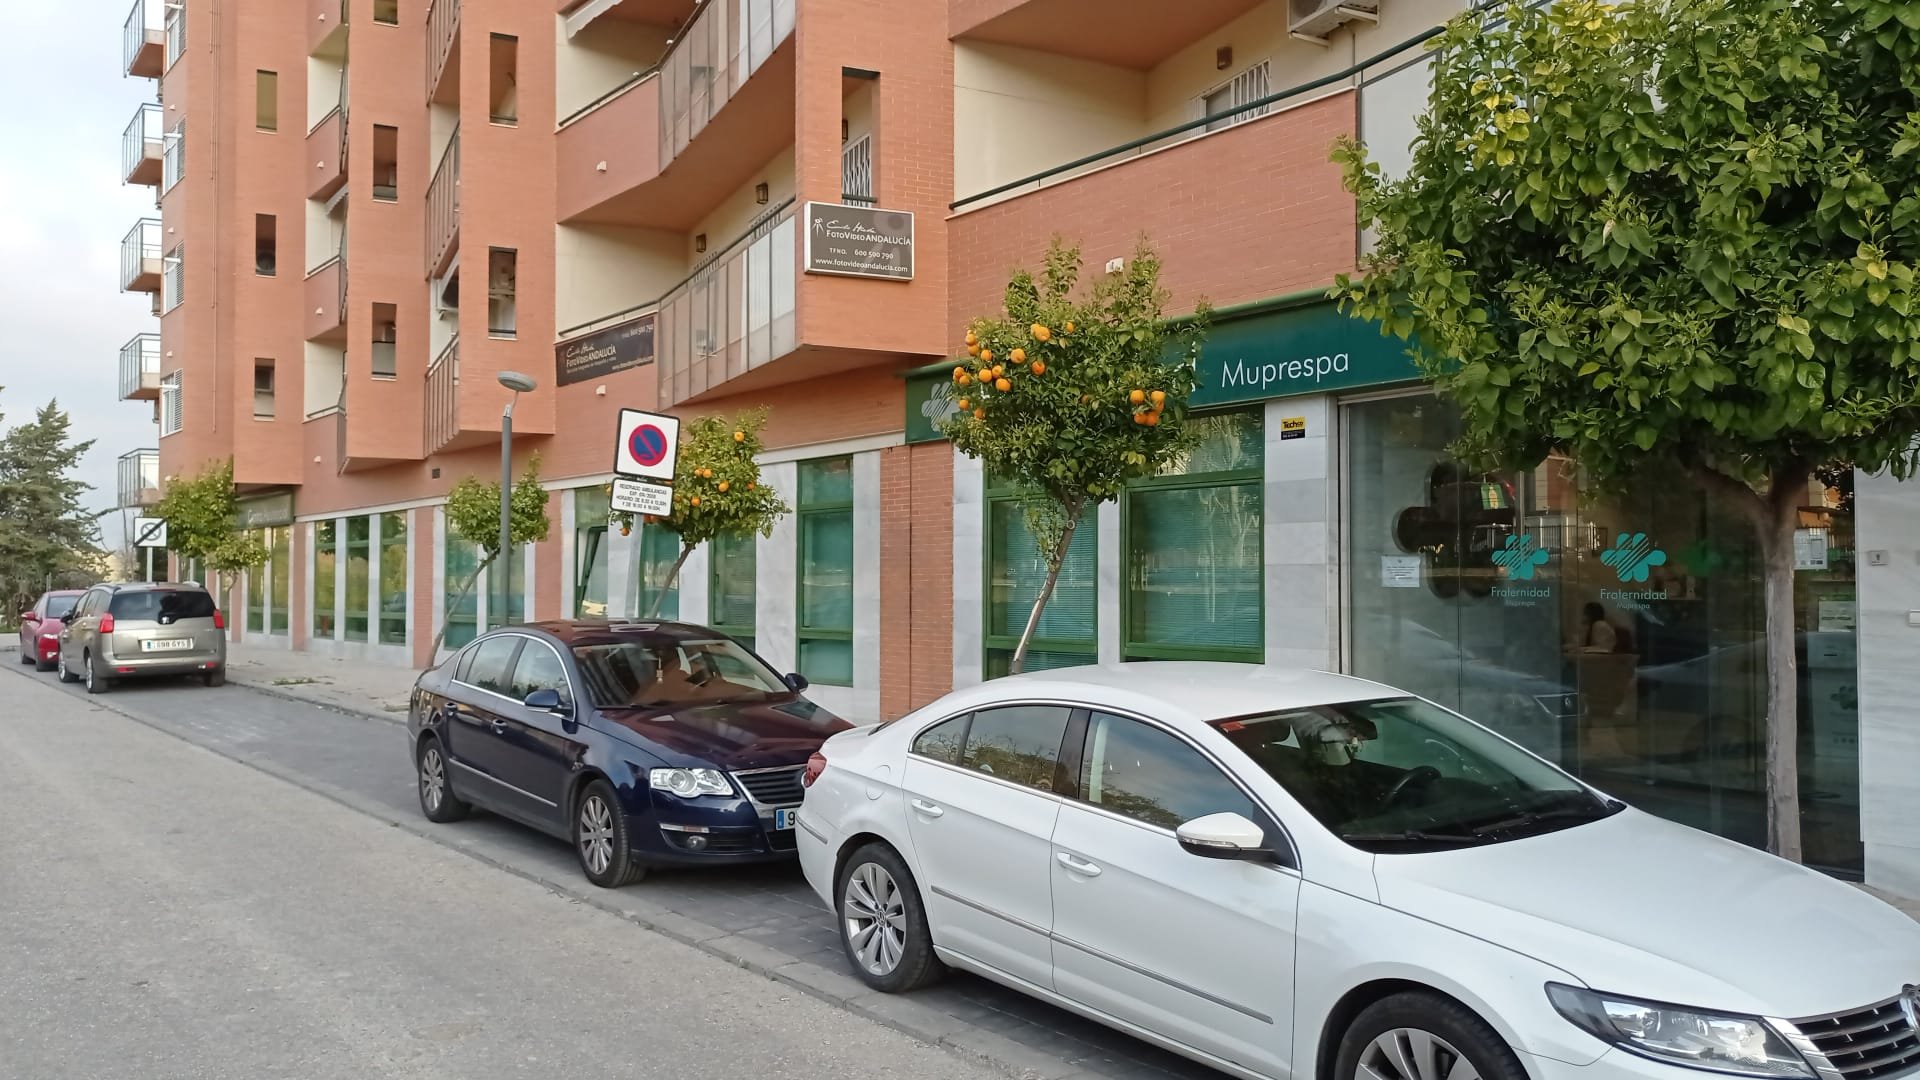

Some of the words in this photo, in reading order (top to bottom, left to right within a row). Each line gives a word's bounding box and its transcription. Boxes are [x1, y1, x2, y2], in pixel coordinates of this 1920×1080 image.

[854, 249, 867, 257] 600
[881, 252, 894, 260] 790
[815, 258, 908, 273] www.fotovideoandalucia.com
[1221, 352, 1349, 390] Muprespa
[1491, 586, 1550, 598] Fraternidad
[1600, 589, 1667, 600] Fraternidad
